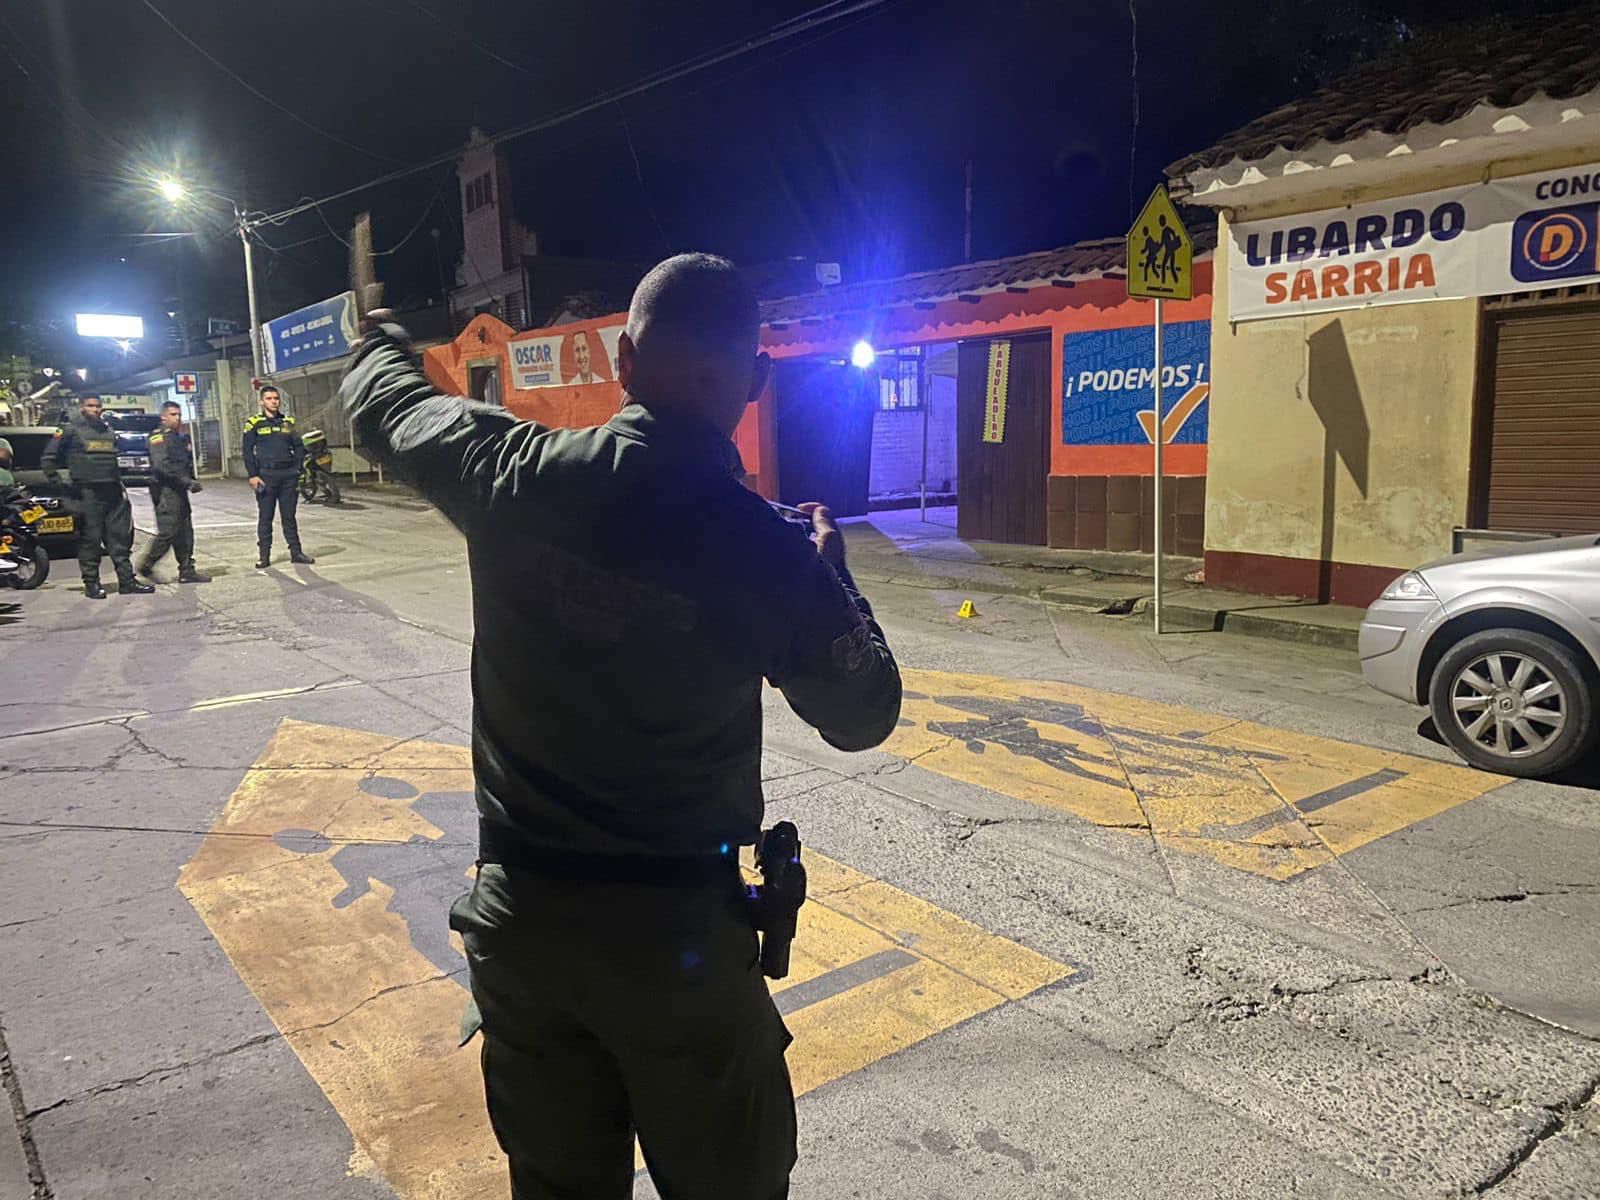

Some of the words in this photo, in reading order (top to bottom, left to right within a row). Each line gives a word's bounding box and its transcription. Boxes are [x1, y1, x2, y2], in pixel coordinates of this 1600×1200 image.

[1246, 202, 1466, 267] LIBARDO
[1265, 253, 1436, 305] SARRIA
[515, 344, 552, 365] OSCAR
